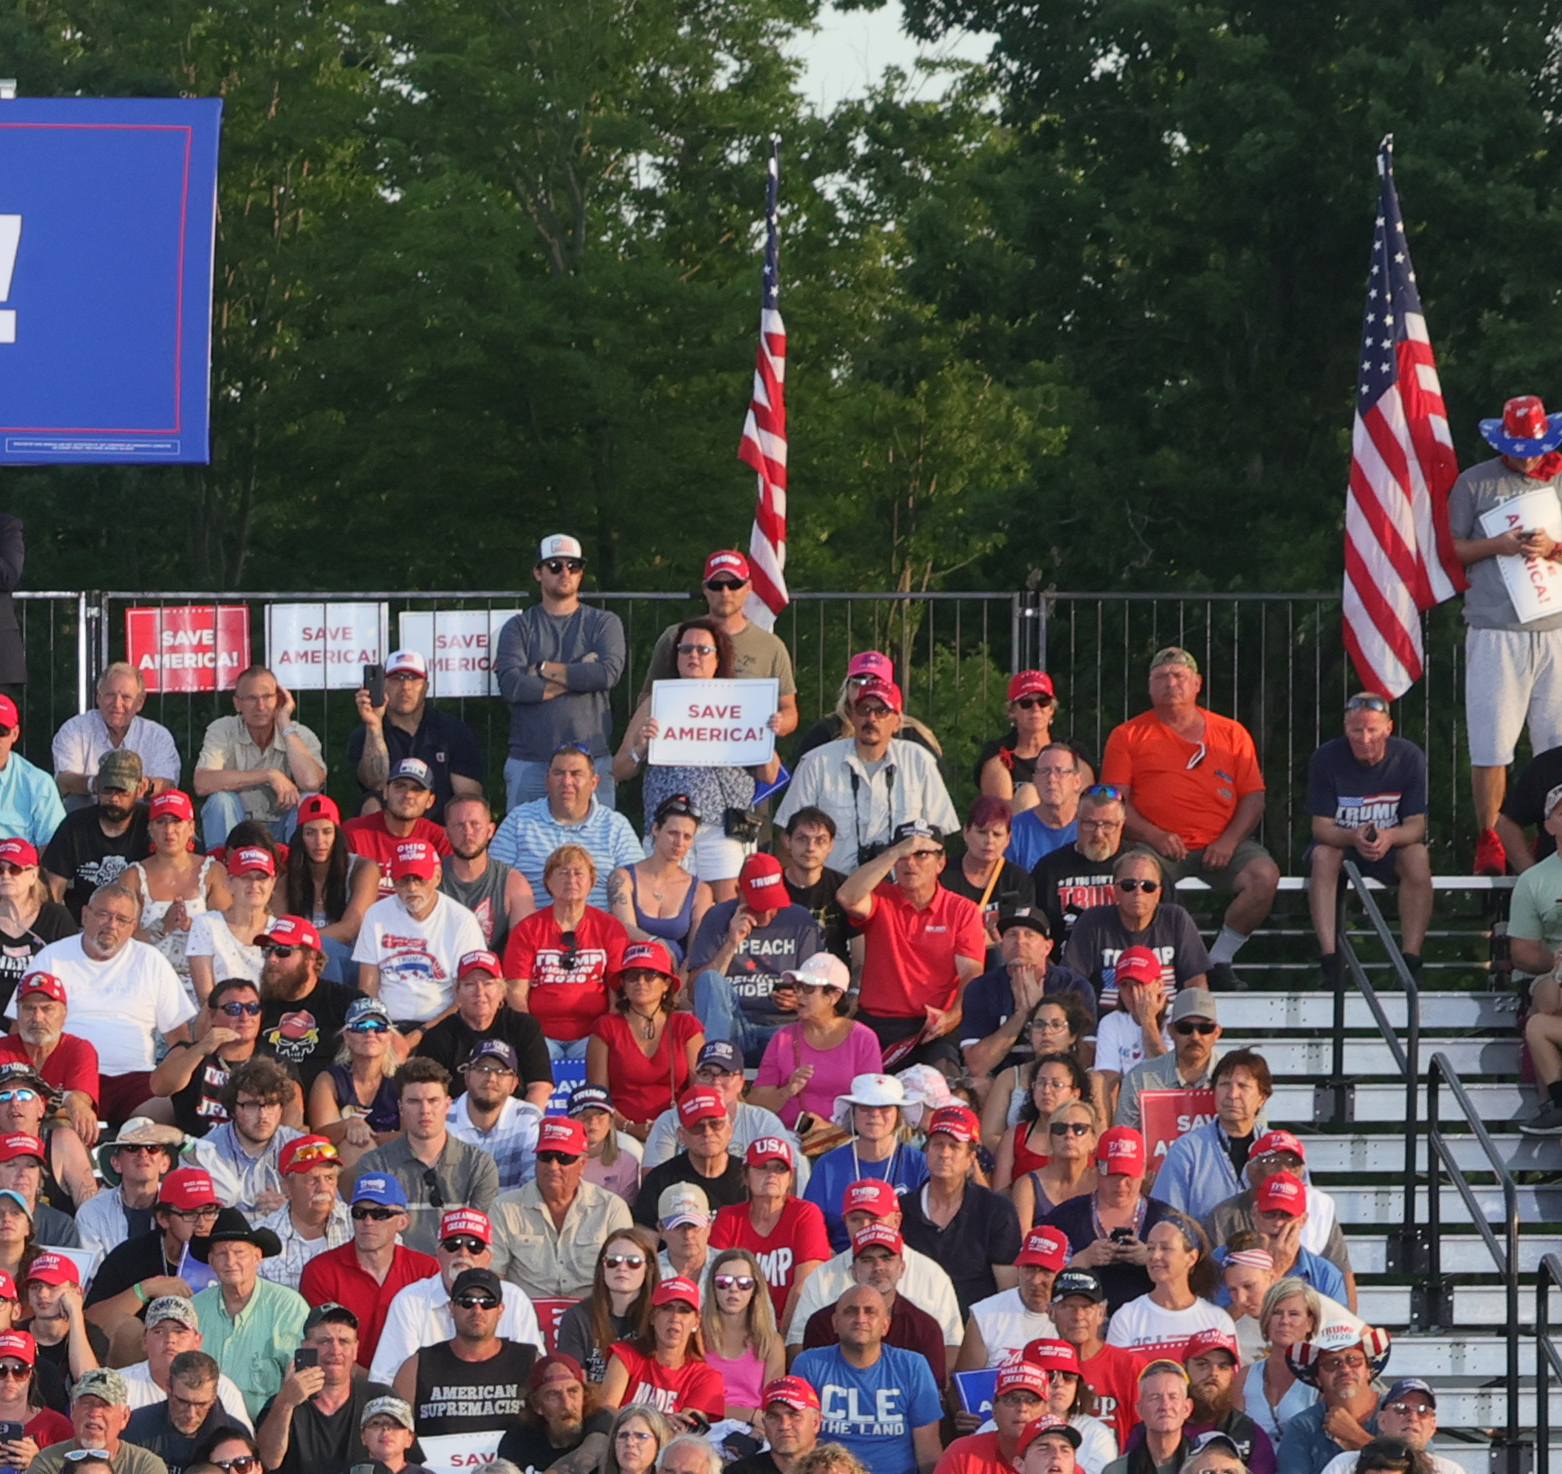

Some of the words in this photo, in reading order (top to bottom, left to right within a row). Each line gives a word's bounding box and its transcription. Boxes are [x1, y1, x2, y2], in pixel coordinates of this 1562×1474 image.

[711, 555, 742, 566] TRUMP
[162, 629, 214, 645] SAVE
[302, 627, 353, 641] SAVE
[436, 634, 489, 649] SAVE
[139, 653, 238, 670] AMERICA!
[279, 649, 377, 664] AMERICA!
[688, 705, 742, 719] SAVE
[664, 727, 764, 741] AMERICA!
[398, 843, 426, 852] OHIO
[240, 849, 269, 861] Trump
[399, 853, 426, 861] TRUMP
[750, 875, 781, 888] TRUMP
[545, 974, 586, 984] 2020
[573, 1088, 608, 1102] TRUMP
[545, 1123, 573, 1135] Trump
[1178, 1114, 1219, 1132] SAV
[755, 1139, 788, 1156] USA
[360, 1178, 387, 1190] Trump
[852, 1186, 880, 1197] Trump
[445, 1213, 463, 1223] MAKE
[463, 1212, 487, 1224] AMERICA
[447, 1222, 466, 1231] GREAT
[466, 1222, 485, 1231] AGAIN
[1030, 1236, 1058, 1249] Trump
[1000, 1366, 1017, 1375] MAKE
[1017, 1365, 1045, 1378] AMERICA
[1002, 1374, 1023, 1384] GREAT
[430, 1384, 518, 1400] AMERICAN
[636, 1381, 680, 1414] MADE
[820, 1384, 903, 1422] CLE
[820, 1421, 860, 1434] THE
[862, 1422, 905, 1436] LAND
